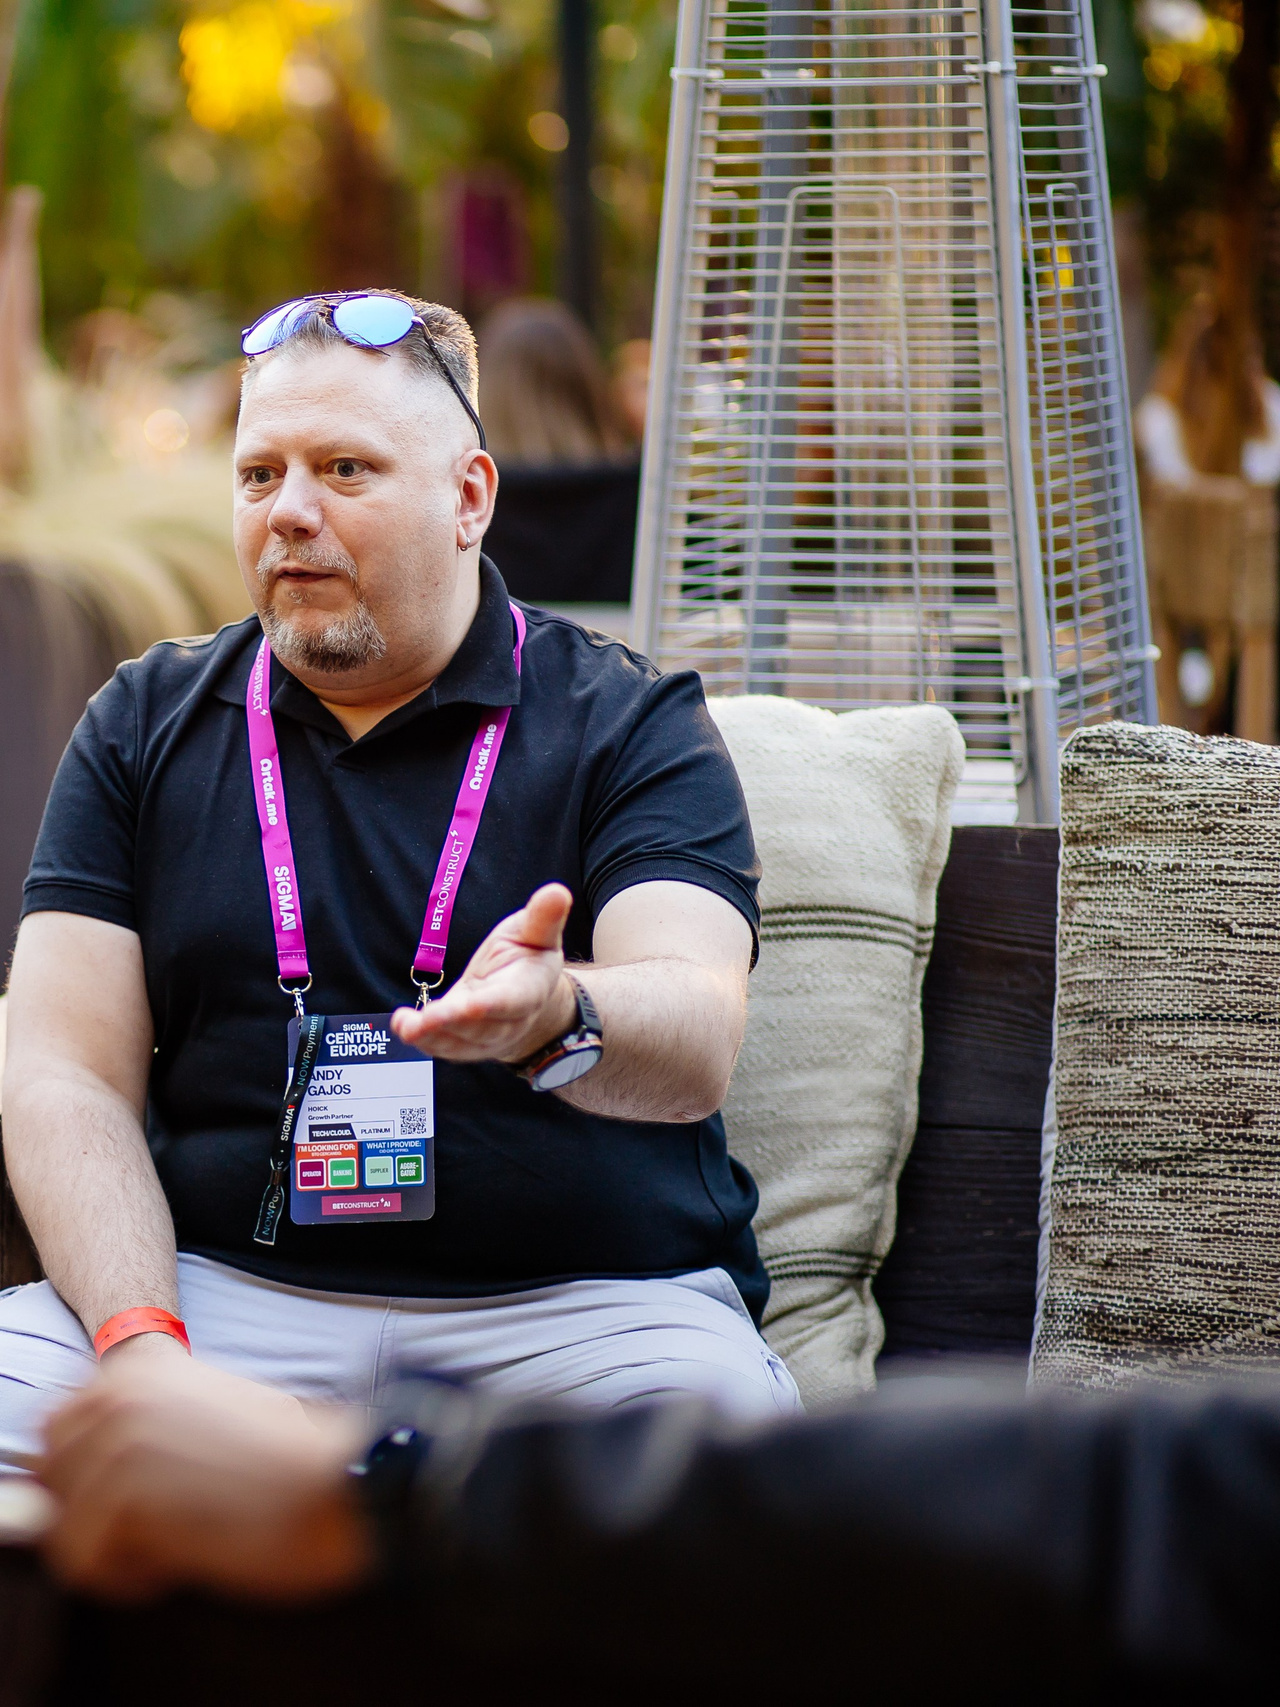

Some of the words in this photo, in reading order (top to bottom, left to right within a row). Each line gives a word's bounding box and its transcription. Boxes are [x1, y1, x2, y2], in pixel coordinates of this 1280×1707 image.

[253, 637, 267, 710] CONSTRUCT
[431, 839, 464, 930] BETCONSTRUCT
[325, 1030, 390, 1045] CENTRAL
[296, 1014, 319, 1086] NOWPayment
[330, 1043, 387, 1057] EUROPE
[308, 1084, 351, 1096] GAJOS
[366, 1141, 386, 1149] WHAT
[391, 1140, 421, 1148] PROVIDE:
[332, 1201, 379, 1209] BETCONSTRUCT
